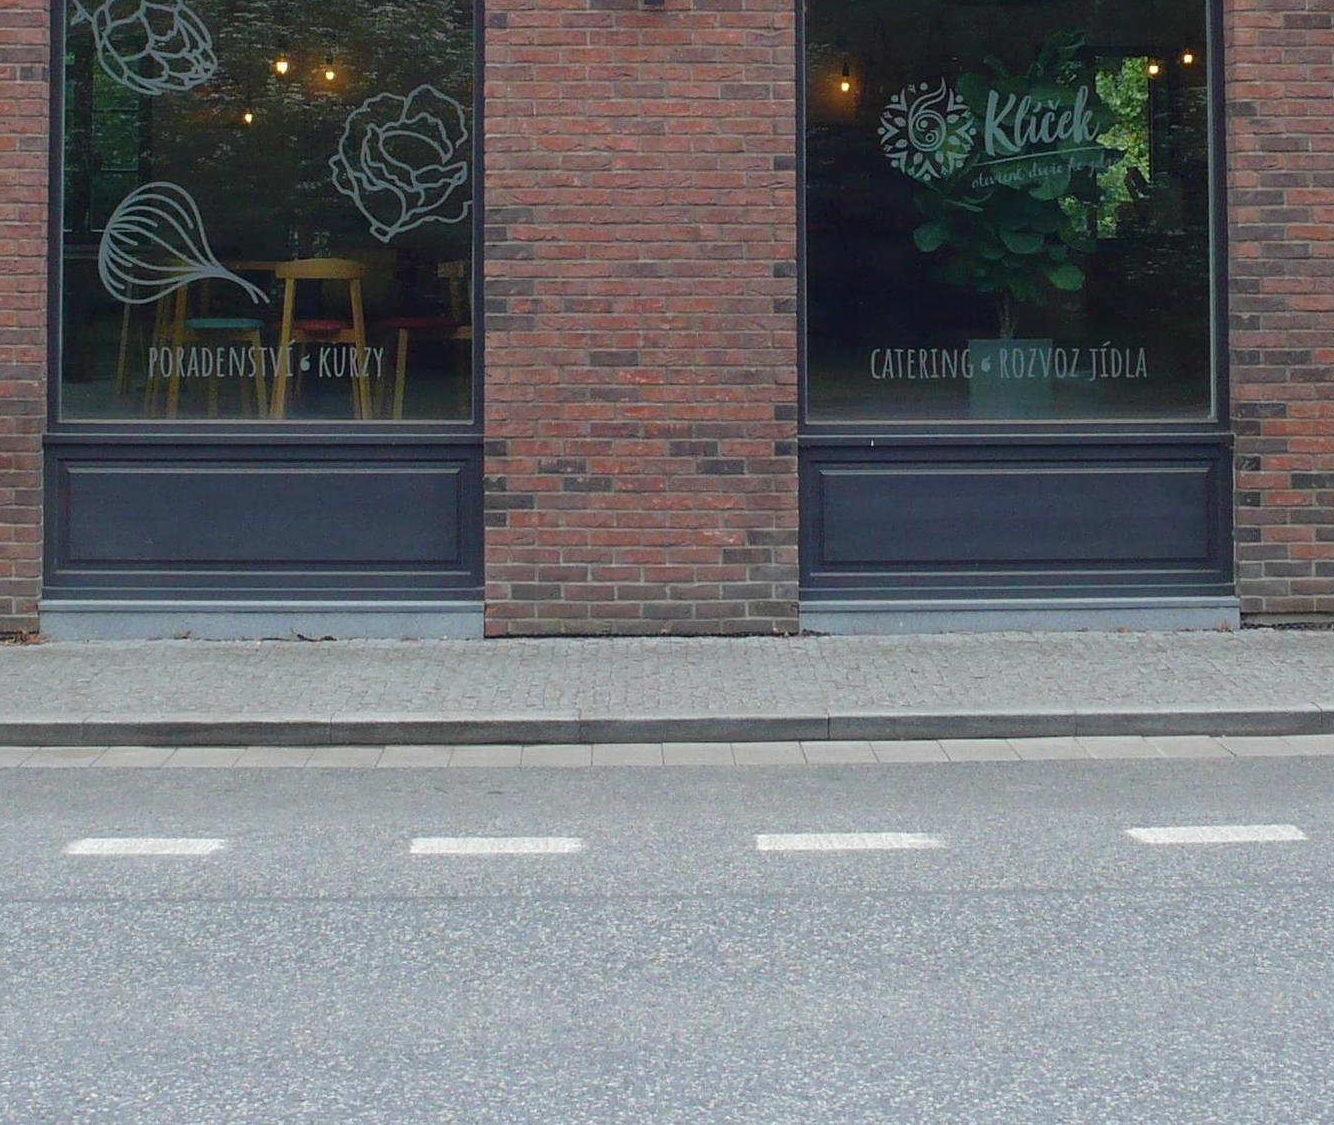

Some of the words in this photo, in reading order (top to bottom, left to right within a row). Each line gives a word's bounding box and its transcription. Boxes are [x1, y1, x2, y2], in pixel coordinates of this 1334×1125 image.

[984, 84, 1100, 157] Klíček
[148, 339, 296, 378] PORADENSTVÍ
[318, 346, 385, 378] KURZY
[870, 347, 974, 380] CATERING
[999, 346, 1081, 379] ROZVOZ
[1088, 340, 1149, 382] JÍDLA
